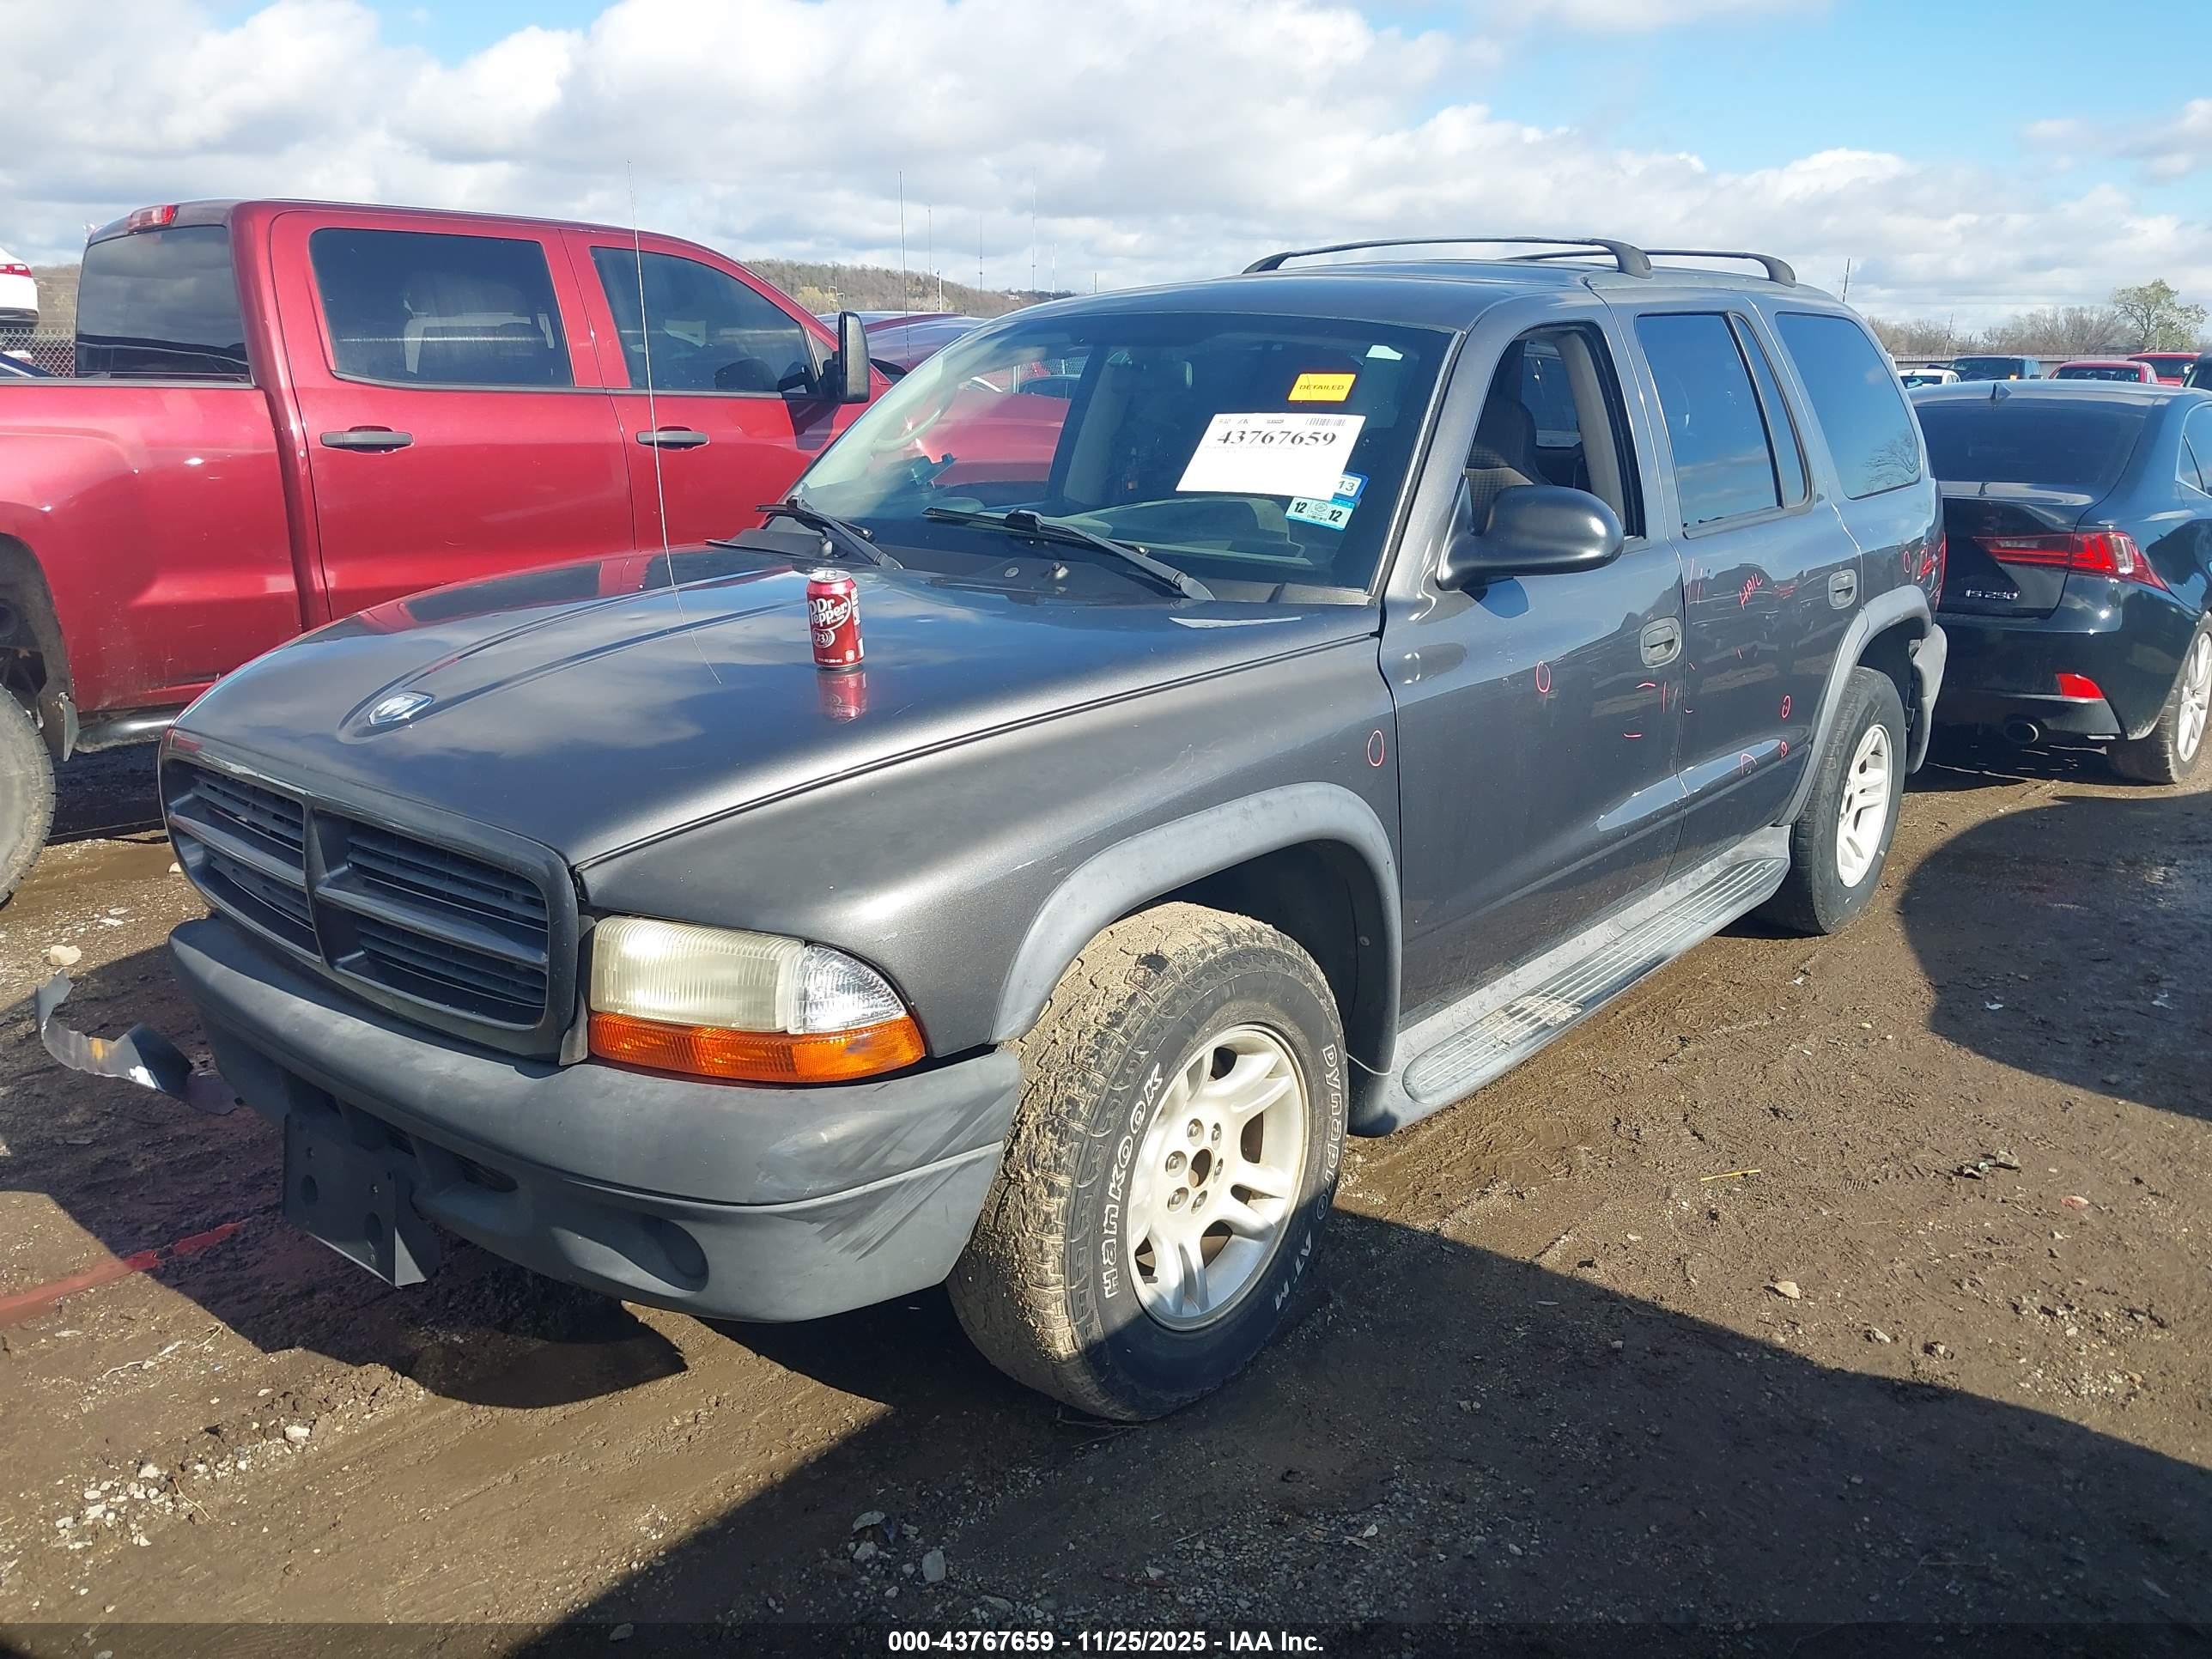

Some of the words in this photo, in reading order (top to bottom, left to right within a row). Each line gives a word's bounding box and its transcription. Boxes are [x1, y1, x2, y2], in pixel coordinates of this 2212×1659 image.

[1217, 429, 1337, 447] 43767659
[1338, 480, 1355, 492] 13
[1294, 501, 1308, 514] 12
[1328, 509, 1343, 522] 12
[1739, 573, 1763, 611] HAIL
[816, 599, 835, 613] Dr
[808, 600, 848, 627] Pepper
